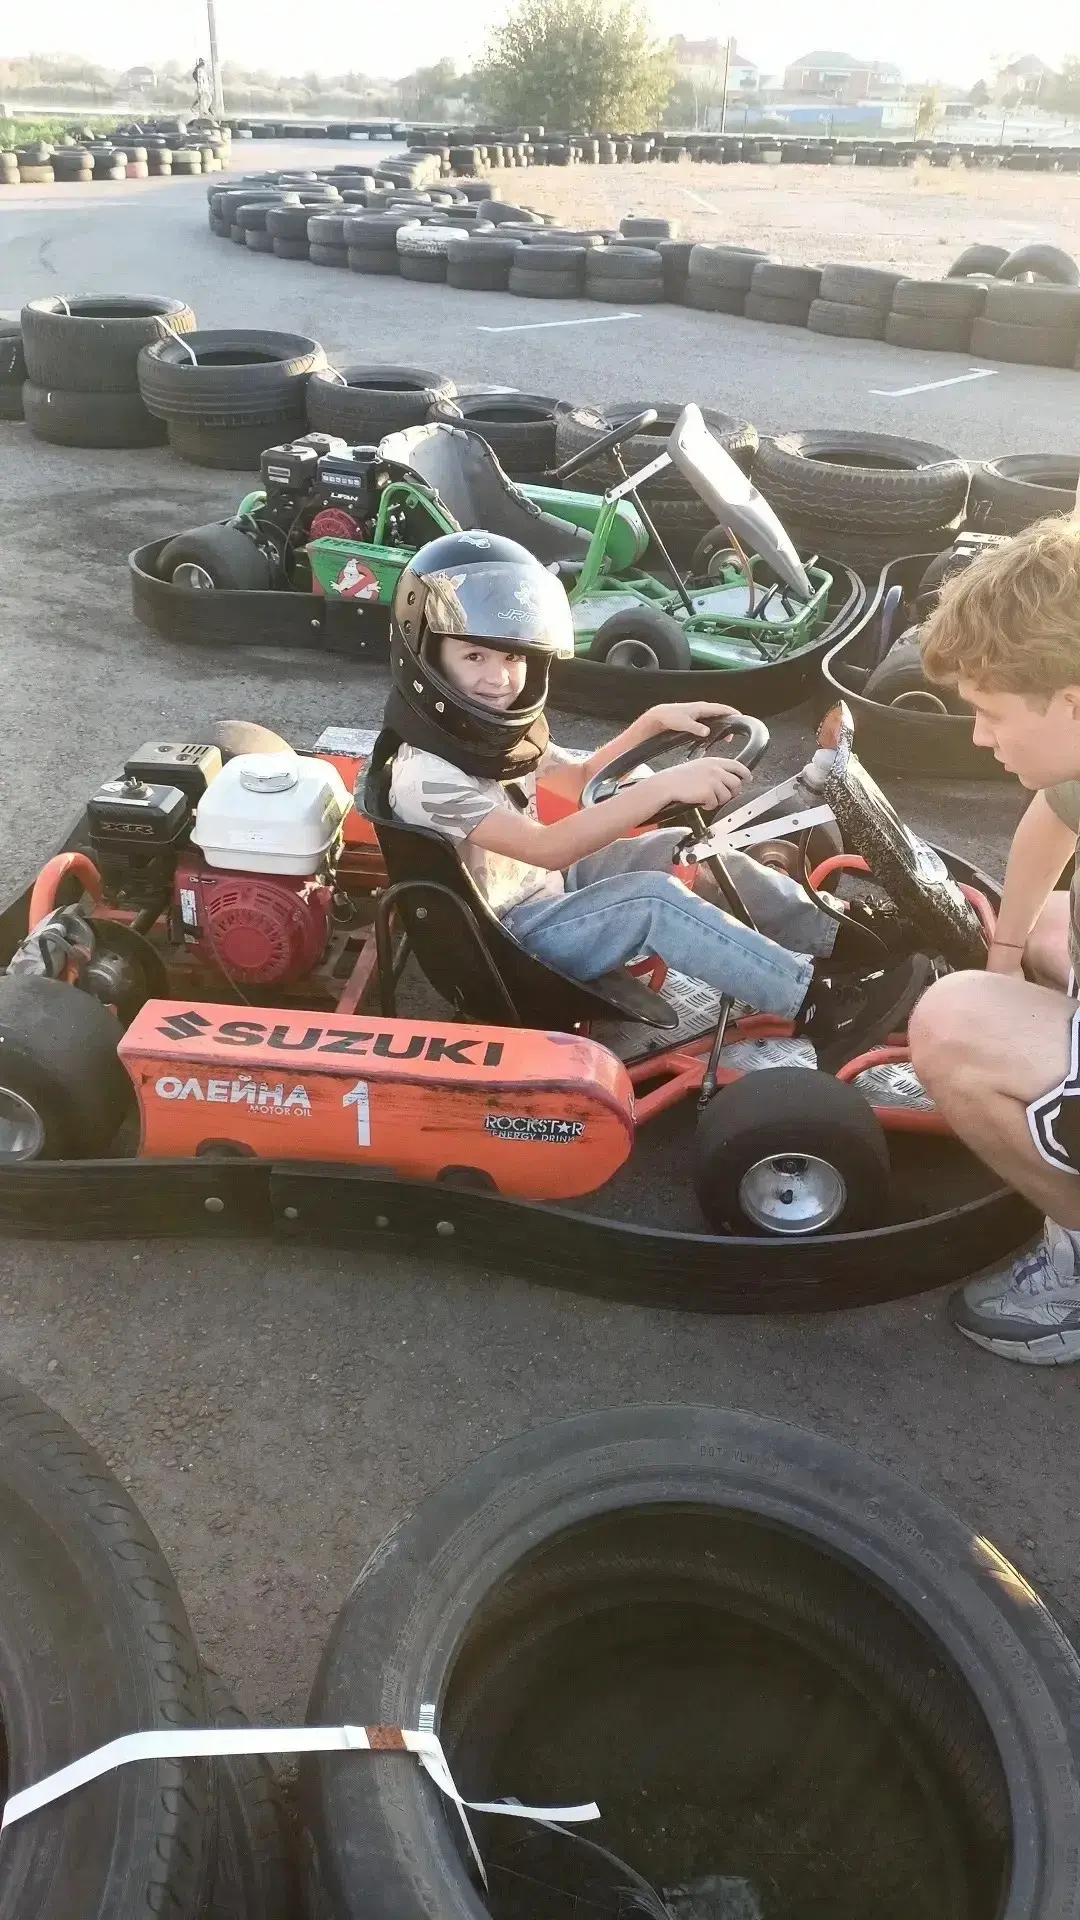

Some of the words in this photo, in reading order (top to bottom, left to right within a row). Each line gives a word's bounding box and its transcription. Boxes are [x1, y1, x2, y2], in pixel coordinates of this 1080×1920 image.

[212, 1021, 504, 1067] SUZUKI
[155, 1074, 312, 1109] ОЛЕЙНА
[249, 1104, 291, 1116] MOTOR
[293, 1107, 313, 1117] OIL
[342, 1081, 371, 1146] 1
[491, 1129, 537, 1141] ENERGY
